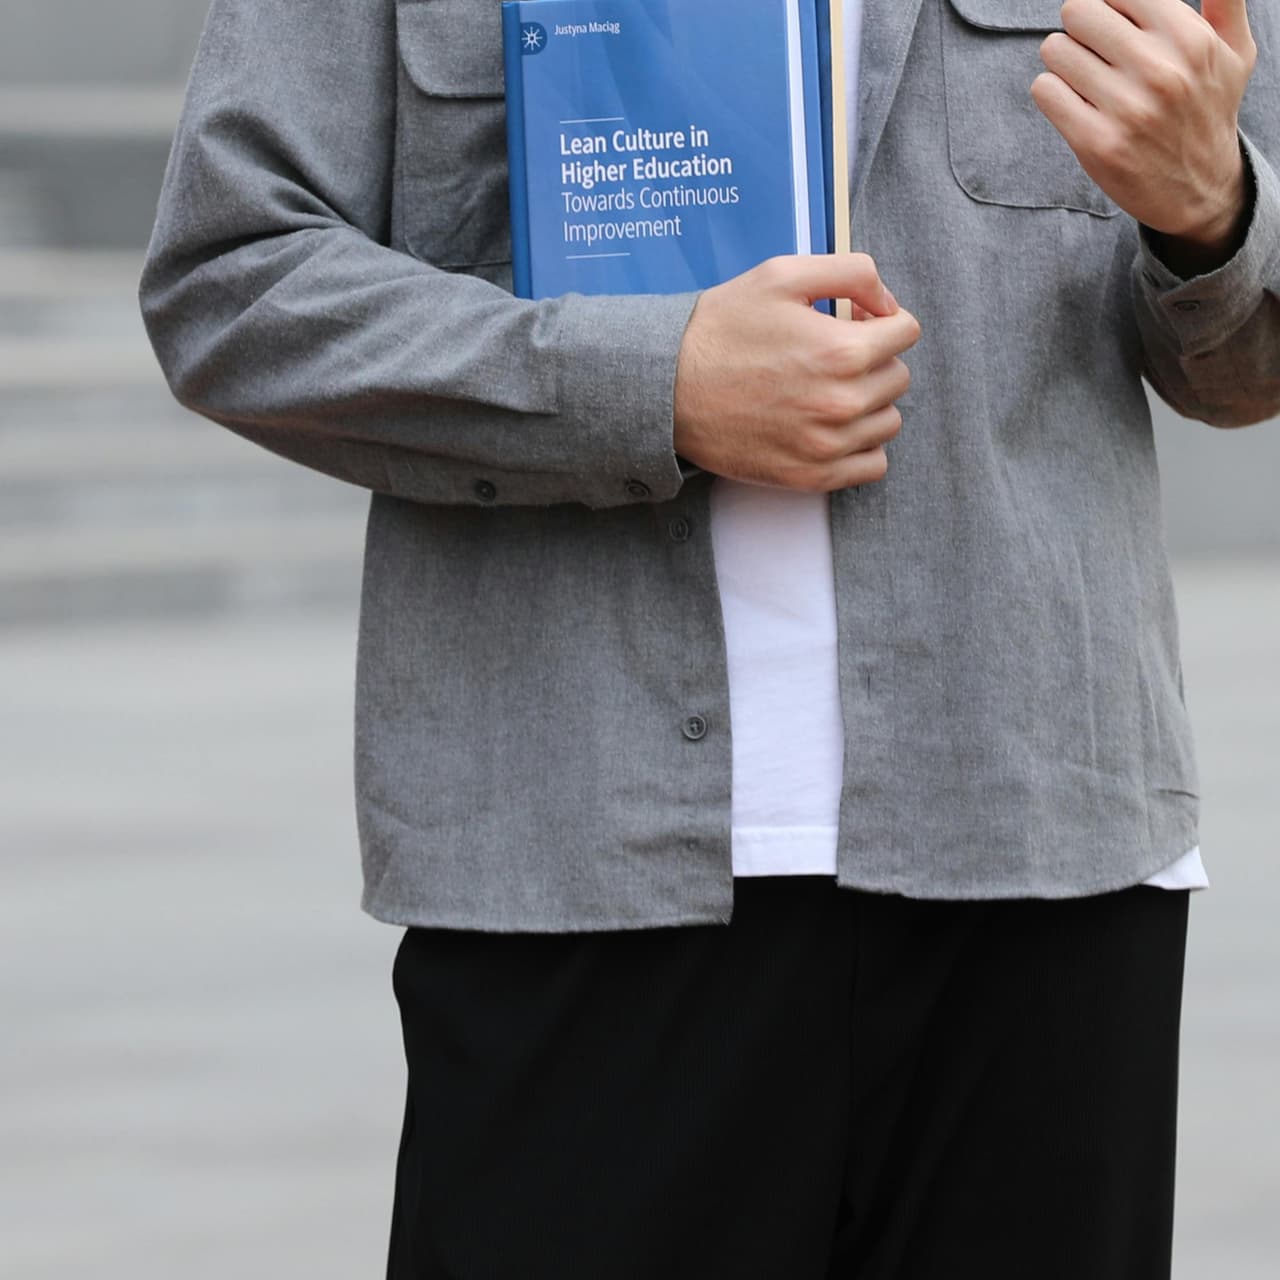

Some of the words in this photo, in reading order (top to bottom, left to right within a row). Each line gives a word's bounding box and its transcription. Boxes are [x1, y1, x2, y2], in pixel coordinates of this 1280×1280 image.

[554, 24, 587, 37] Justyna
[560, 133, 607, 155] Lean
[612, 128, 685, 152] Culture
[690, 125, 709, 148] in
[561, 160, 627, 189] Higher
[633, 154, 732, 180] Education
[561, 188, 635, 213] Towards
[639, 185, 740, 208] Continuous
[564, 216, 682, 246] Improvement
